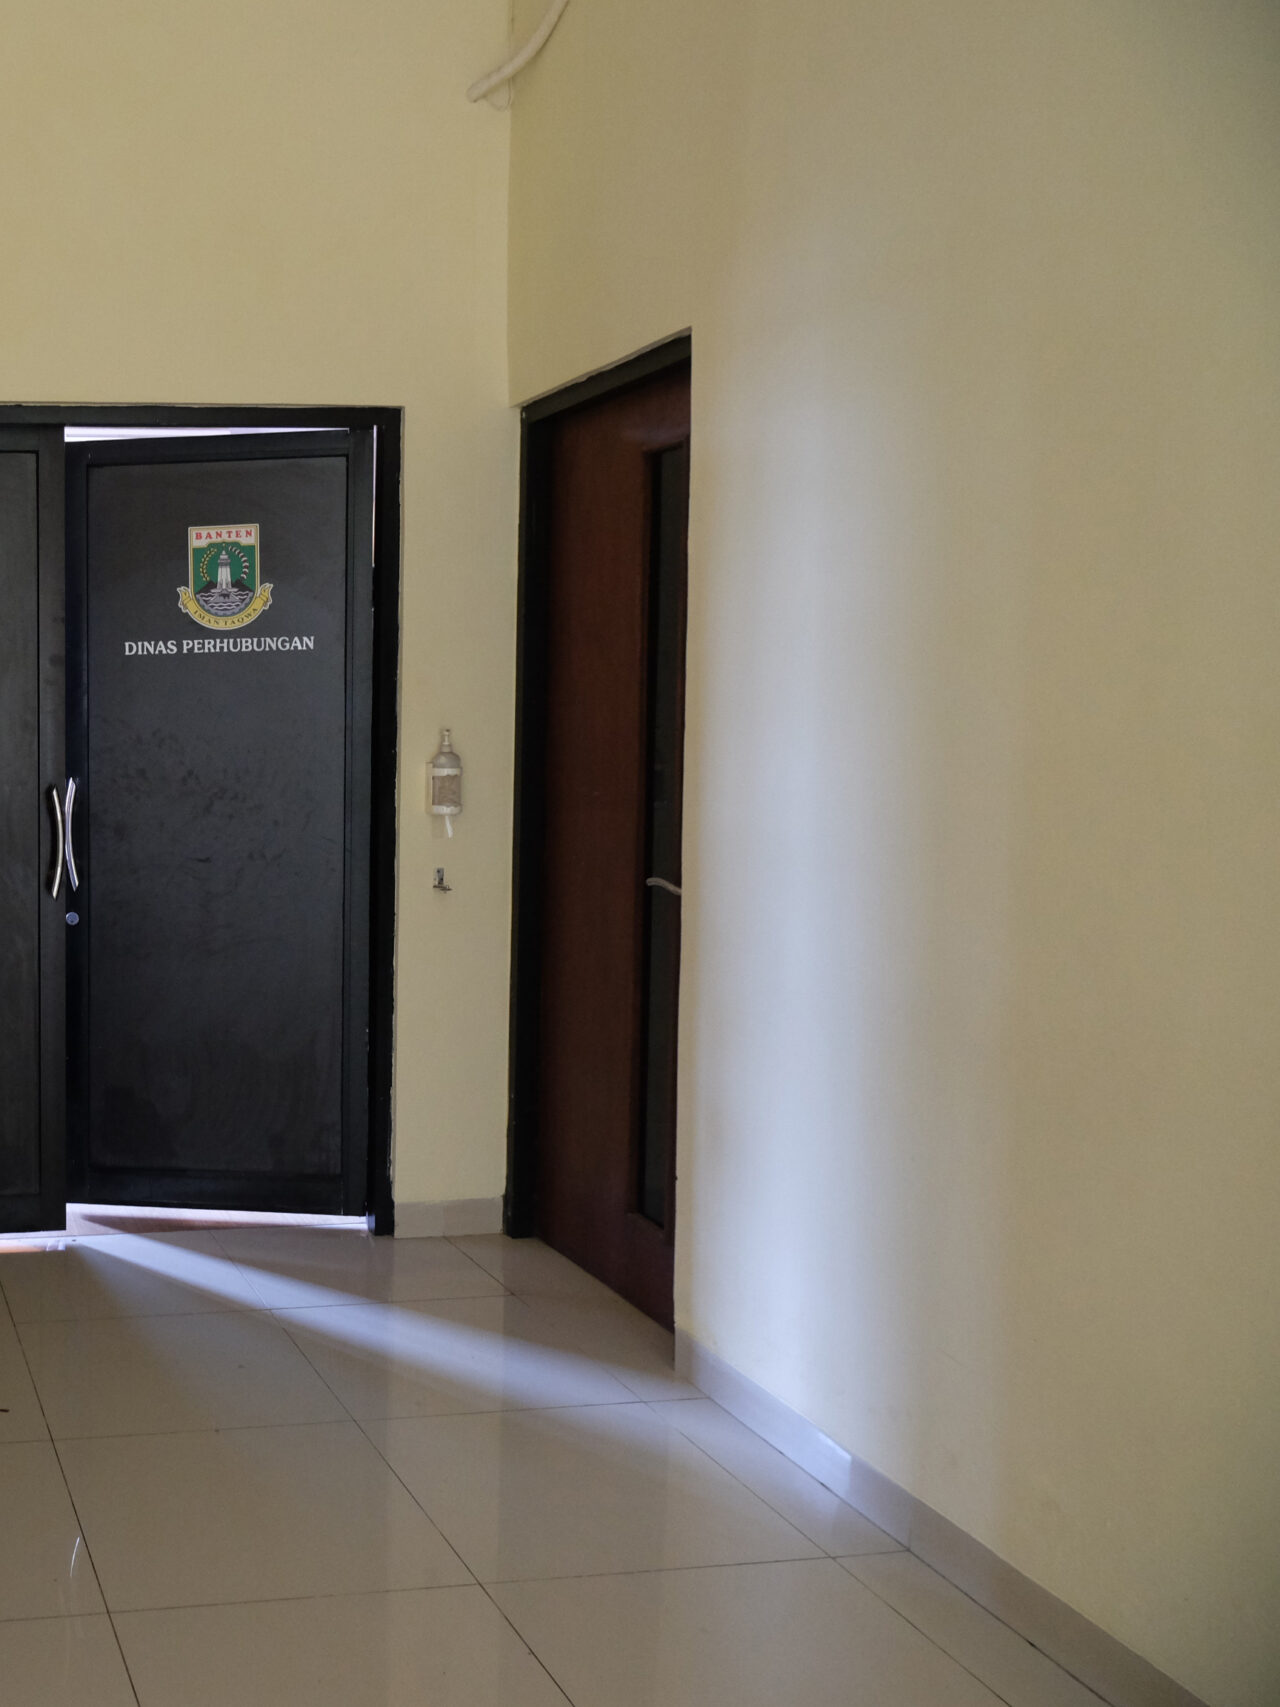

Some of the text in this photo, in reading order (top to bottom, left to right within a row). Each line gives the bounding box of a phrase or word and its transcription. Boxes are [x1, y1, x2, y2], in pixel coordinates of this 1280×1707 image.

[195, 529, 253, 540] BANTEN
[193, 608, 258, 626] IMAN TAQWA
[124, 636, 315, 655] DINAS PERHUBUNGAN
